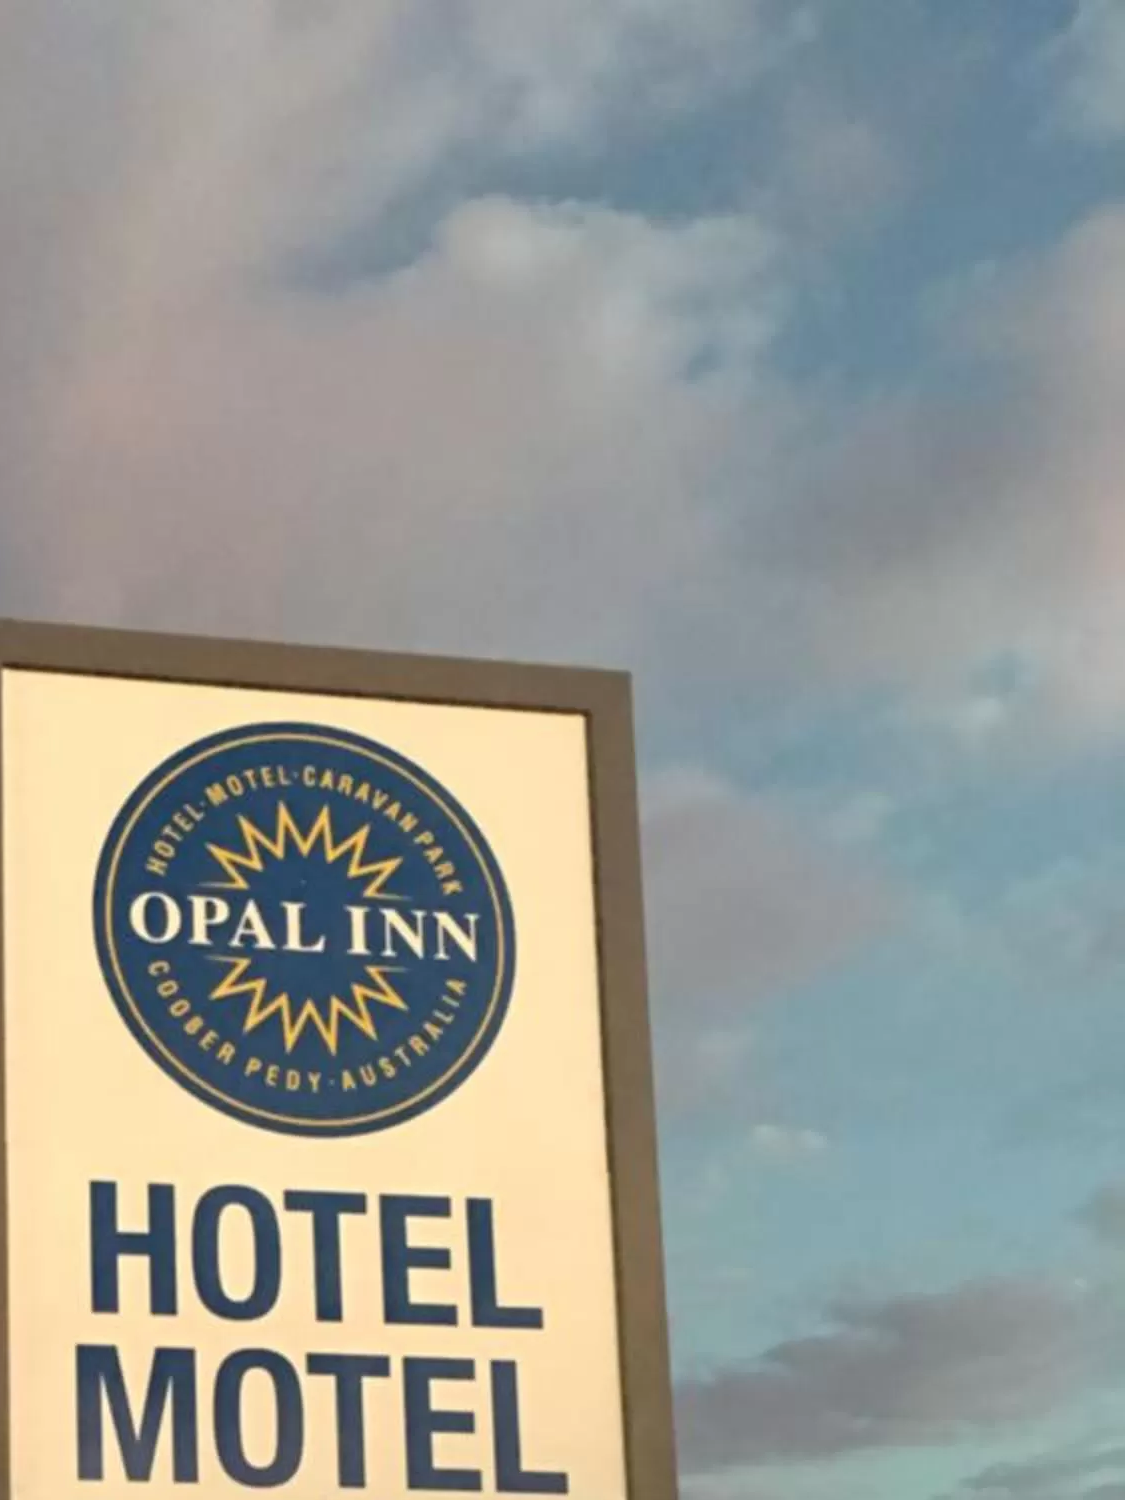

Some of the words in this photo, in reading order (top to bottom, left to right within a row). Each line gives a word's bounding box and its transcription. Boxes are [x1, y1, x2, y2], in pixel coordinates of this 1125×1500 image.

[145, 802, 205, 876] HOTEL
[204, 765, 291, 807] MOTEL
[303, 764, 417, 833] CARAVAN
[414, 831, 464, 895] PARK
[129, 891, 326, 952] OPAL
[344, 904, 480, 961] INN
[148, 960, 235, 1064] COOBER
[244, 1057, 322, 1092] PEDY
[341, 978, 467, 1091] AUSTRALIA
[89, 1180, 543, 1330] HOTEL
[75, 1343, 569, 1495] MOTEL
